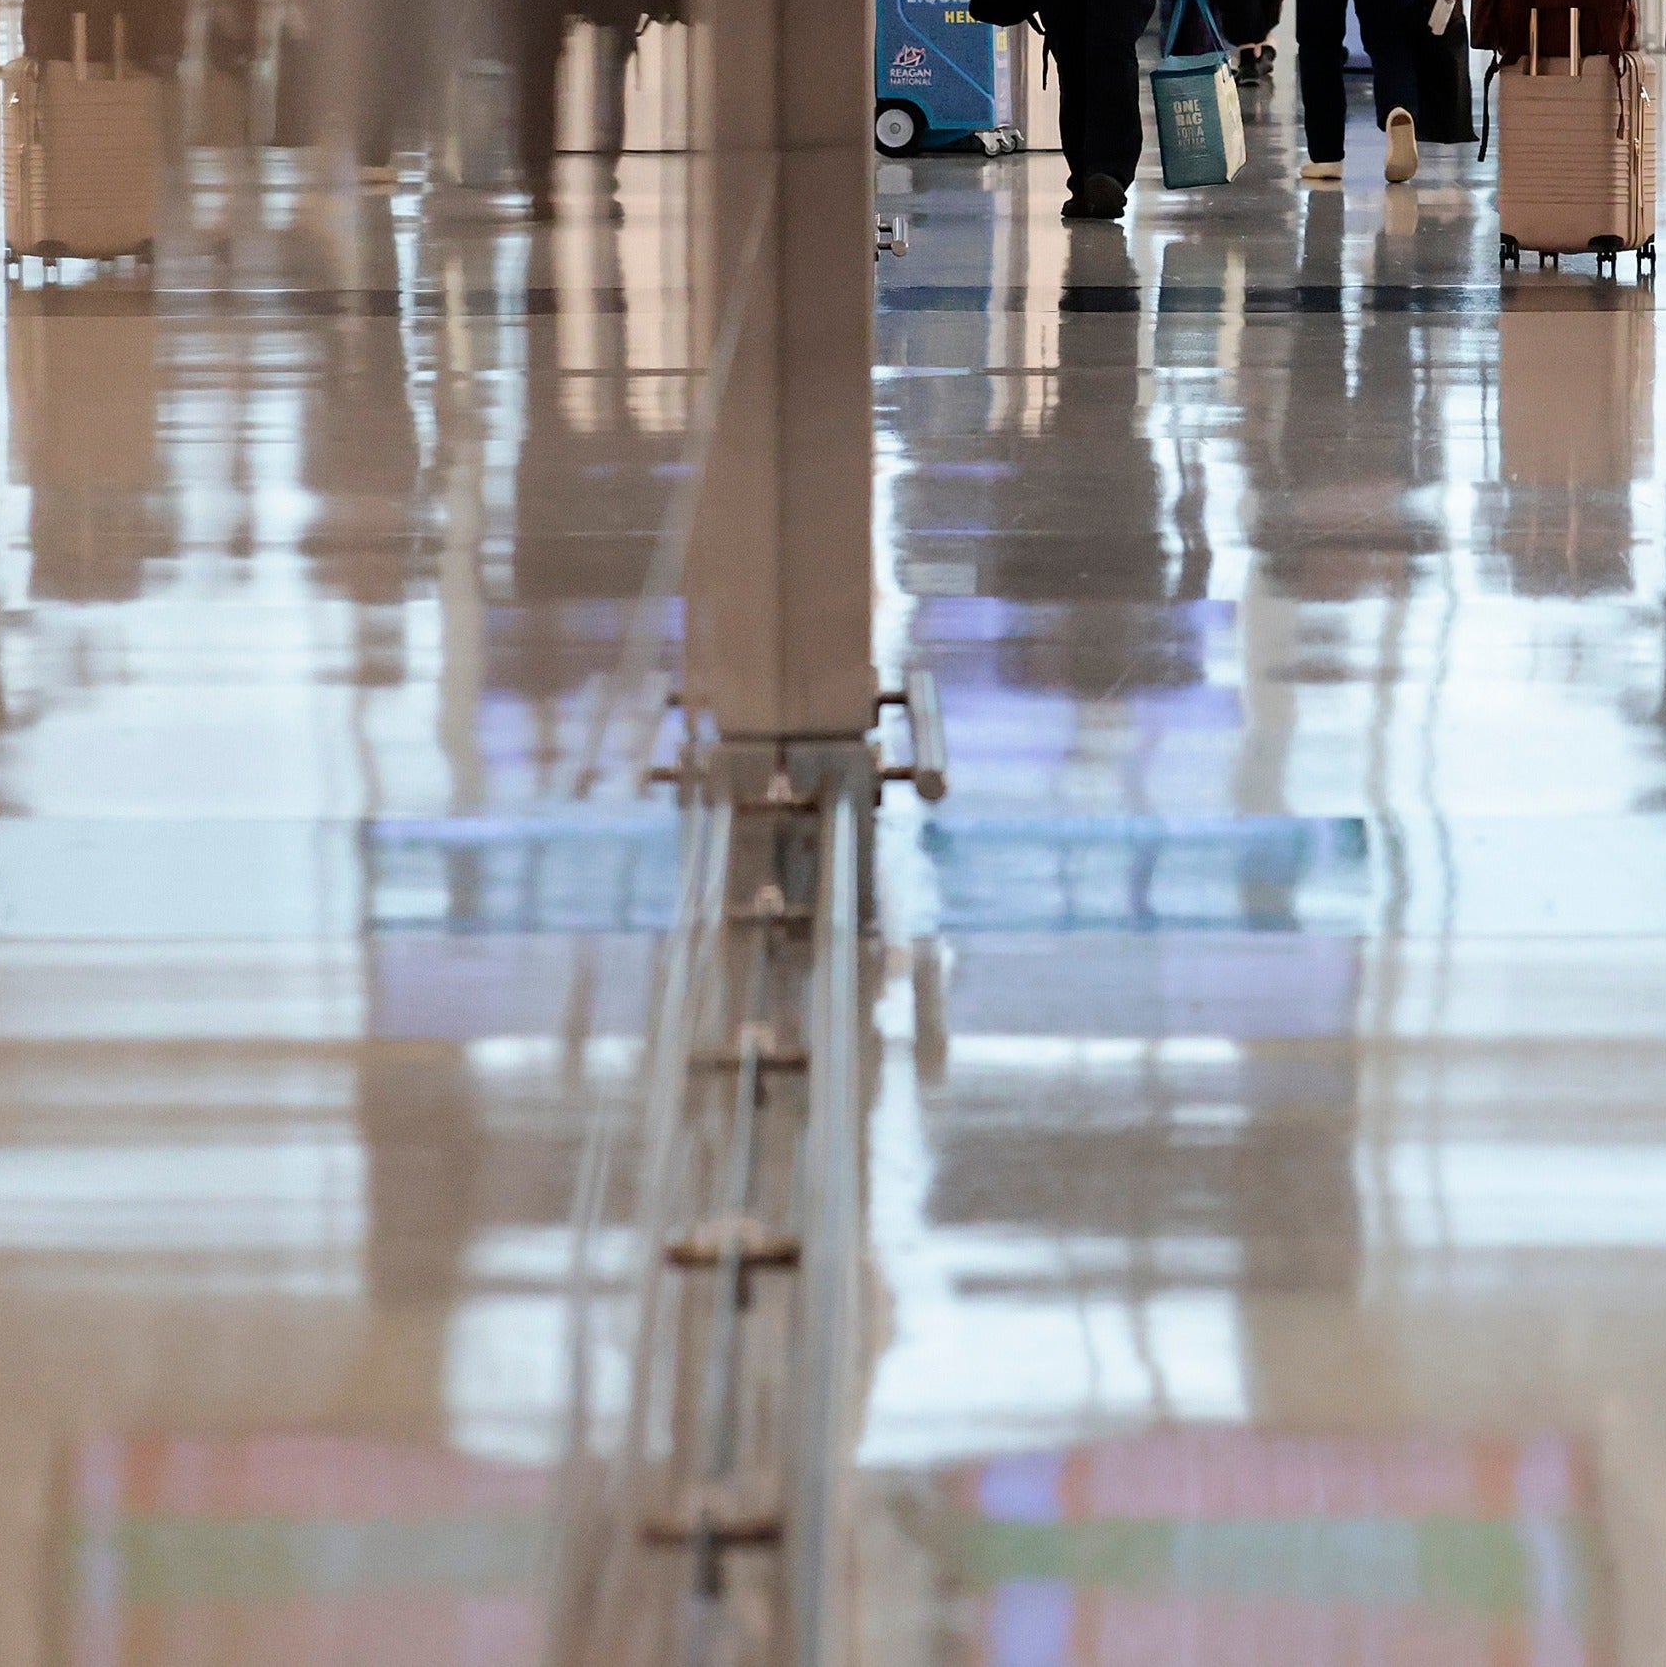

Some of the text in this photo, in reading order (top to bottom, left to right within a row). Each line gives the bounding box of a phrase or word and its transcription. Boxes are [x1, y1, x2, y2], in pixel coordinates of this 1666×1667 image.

[944, 10, 978, 23] HER
[890, 68, 932, 78] REAGAN
[890, 78, 932, 86] NATIONAL
[1173, 99, 1200, 113] ONE
[1175, 112, 1203, 126] BAG
